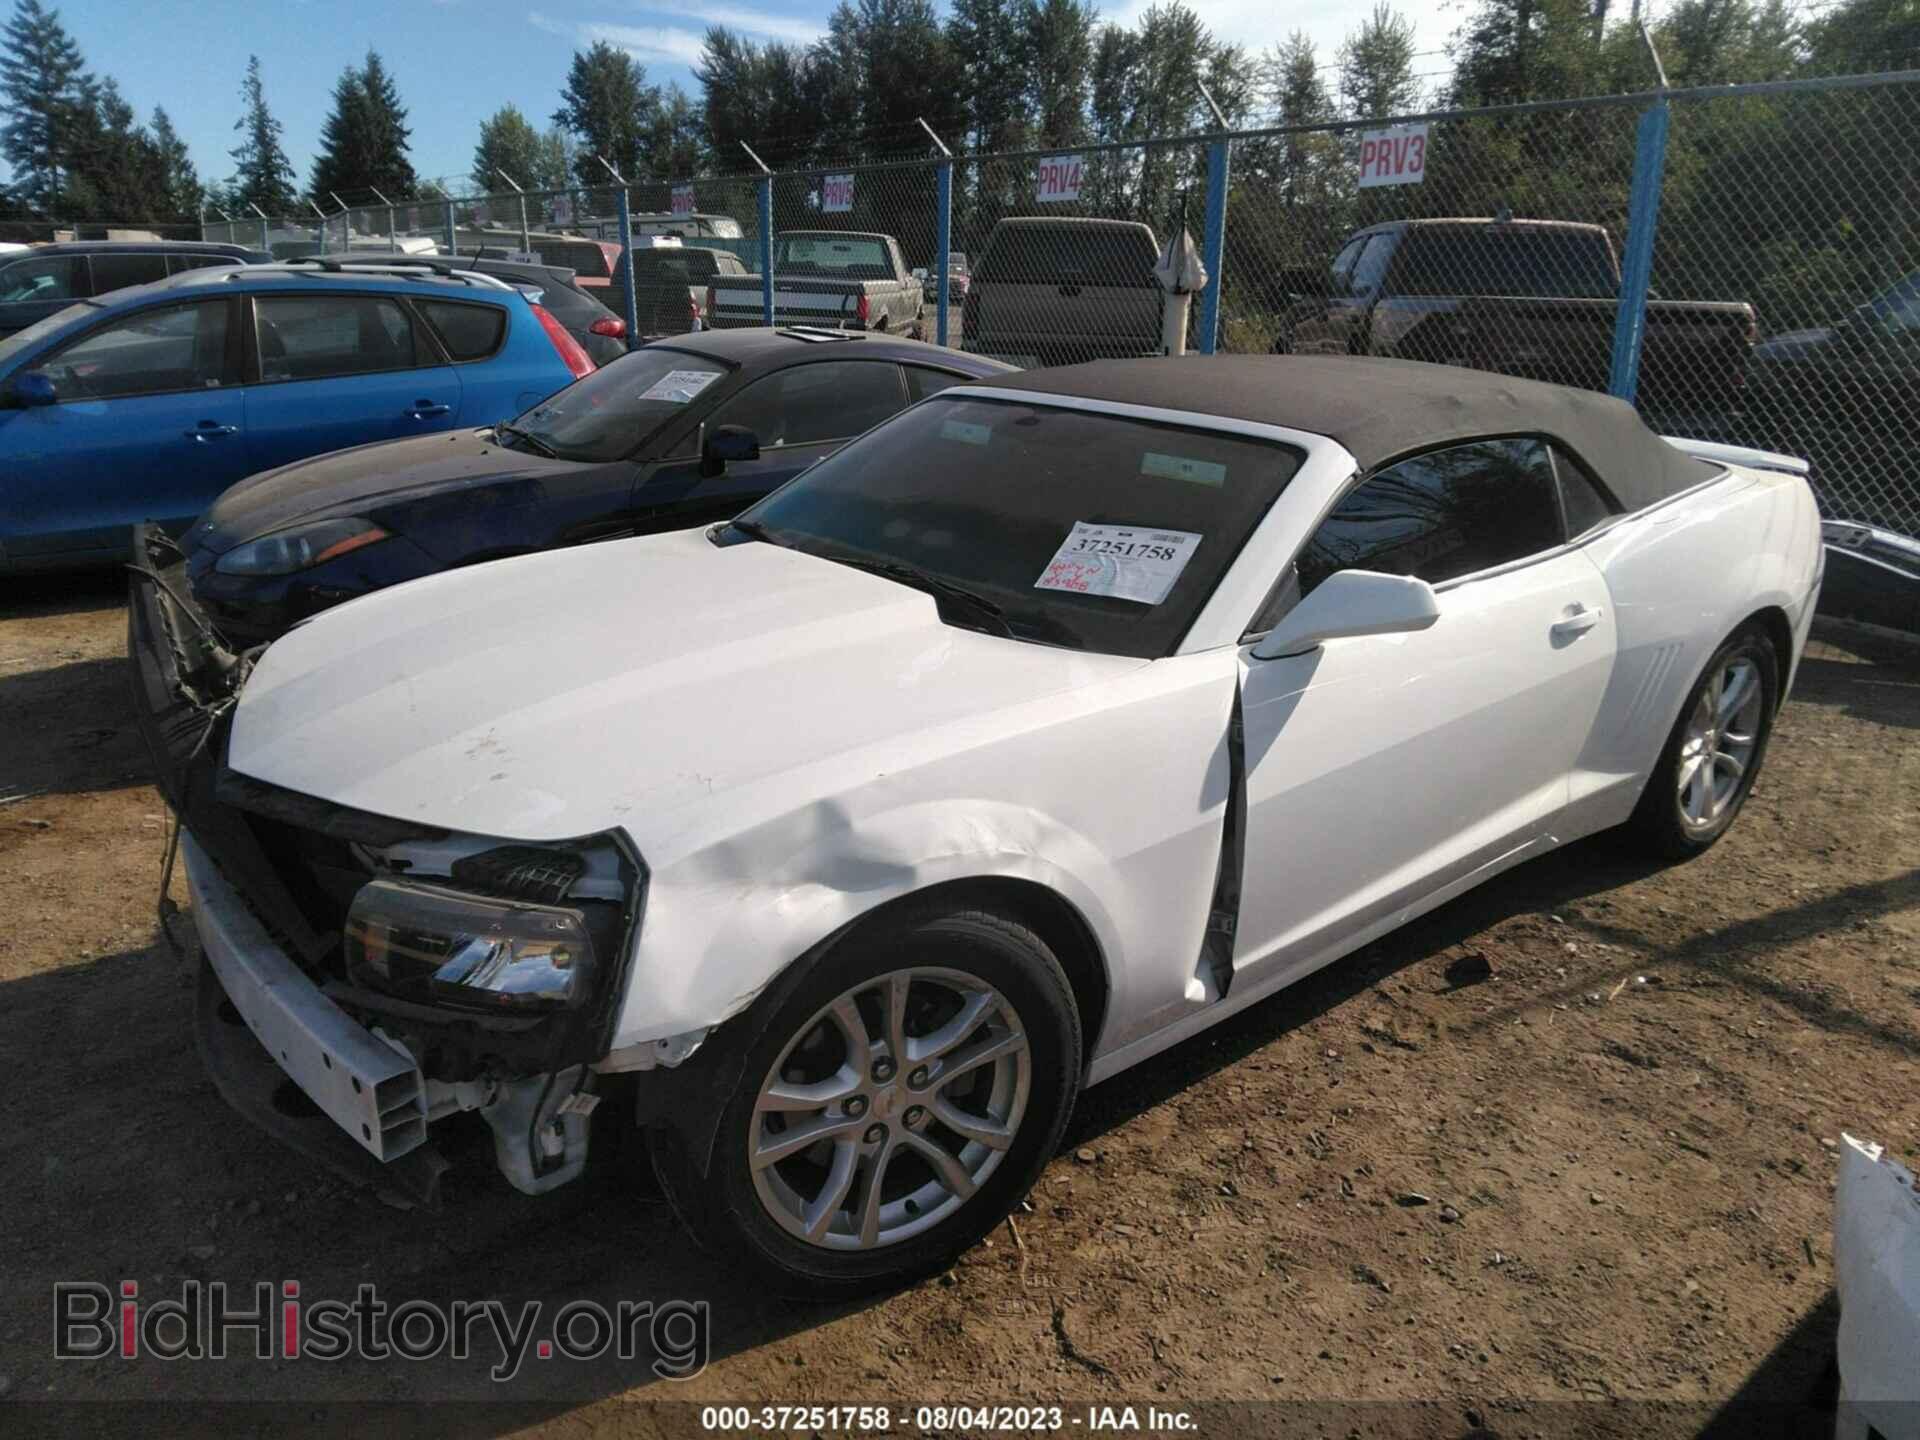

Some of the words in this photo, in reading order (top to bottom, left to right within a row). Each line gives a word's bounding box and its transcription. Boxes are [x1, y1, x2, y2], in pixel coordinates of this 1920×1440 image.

[1360, 134, 1424, 177] PRV3
[1039, 162, 1082, 194] PRV4
[1072, 539, 1176, 561] 37251758
